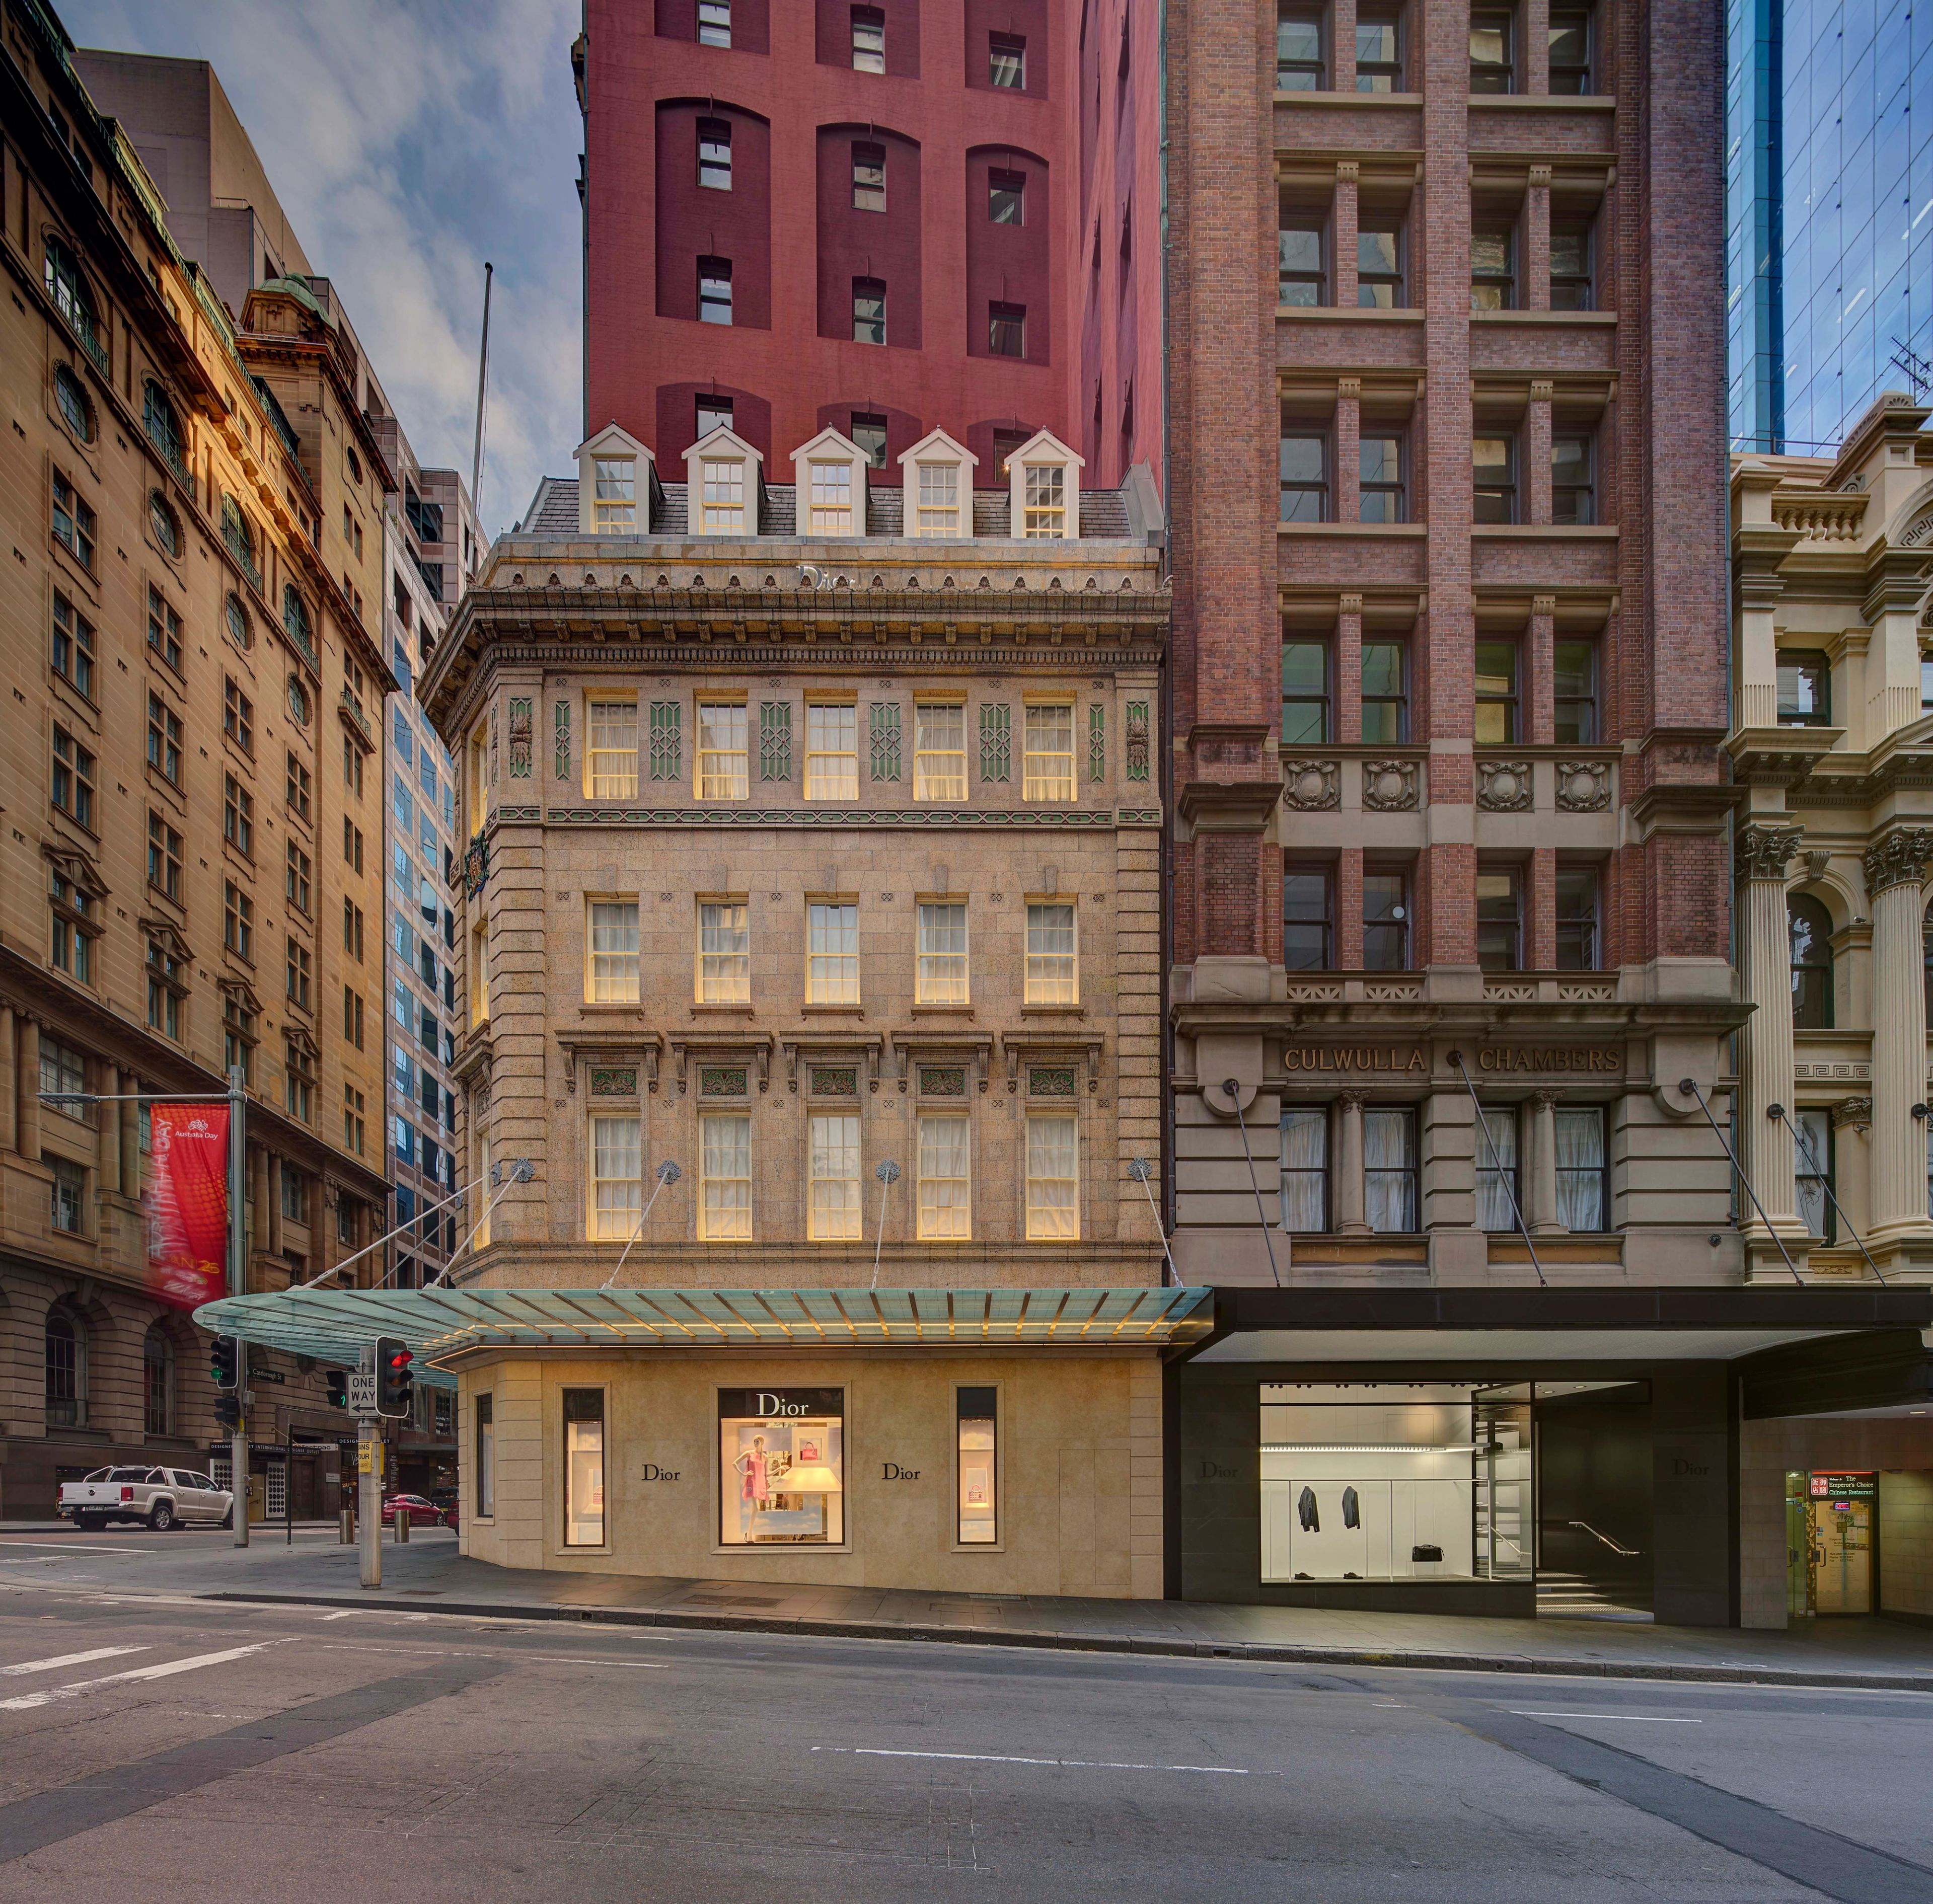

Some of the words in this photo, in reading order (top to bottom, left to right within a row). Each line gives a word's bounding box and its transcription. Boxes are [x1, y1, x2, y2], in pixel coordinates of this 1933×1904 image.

[1284, 1048, 1426, 1071] CULWULLA
[1479, 1048, 1620, 1071] CHAMBERS
[204, 1132, 218, 1140] Day
[253, 1368, 277, 1380] Castlereagh
[352, 1378, 375, 1388] ONE
[351, 1391, 375, 1401] WAY
[755, 1393, 809, 1416] Dior
[641, 1464, 681, 1481] Dior
[881, 1463, 921, 1480] Dior
[1201, 1461, 1238, 1479] Dior
[1672, 1458, 1709, 1476] Dior
